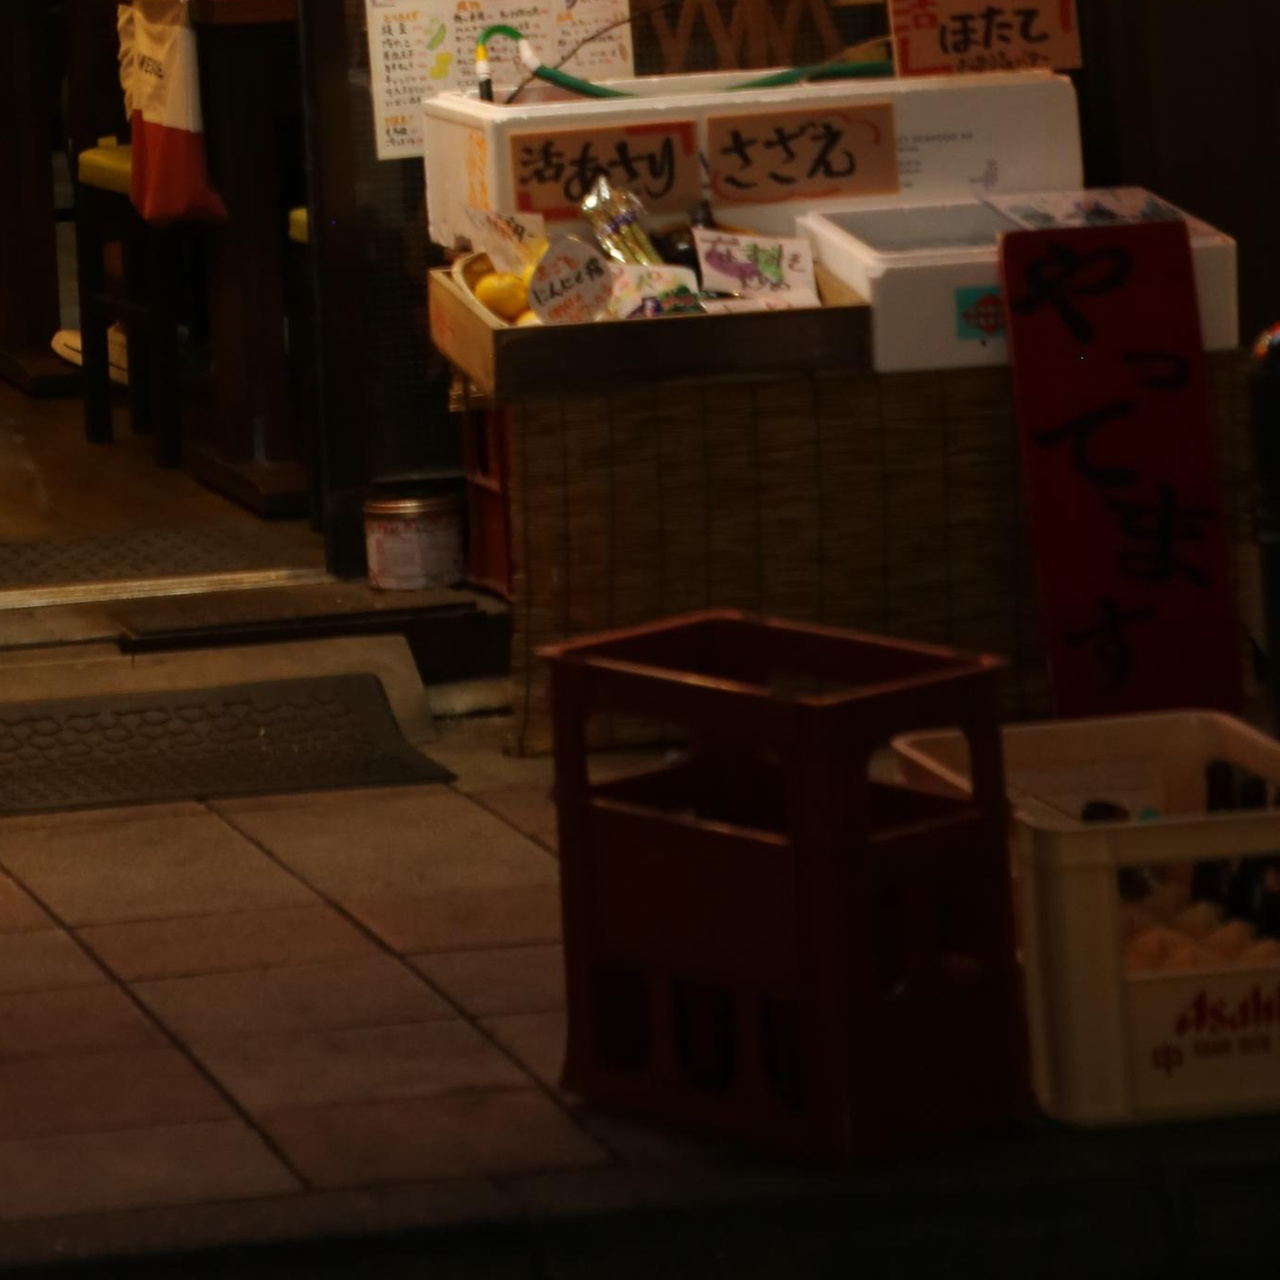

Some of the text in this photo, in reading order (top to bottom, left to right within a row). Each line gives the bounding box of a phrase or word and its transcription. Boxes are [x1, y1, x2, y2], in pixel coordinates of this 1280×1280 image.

[938, 4, 1051, 55] ほたて
[518, 135, 677, 204] 活あさり
[719, 120, 858, 191] さざえ
